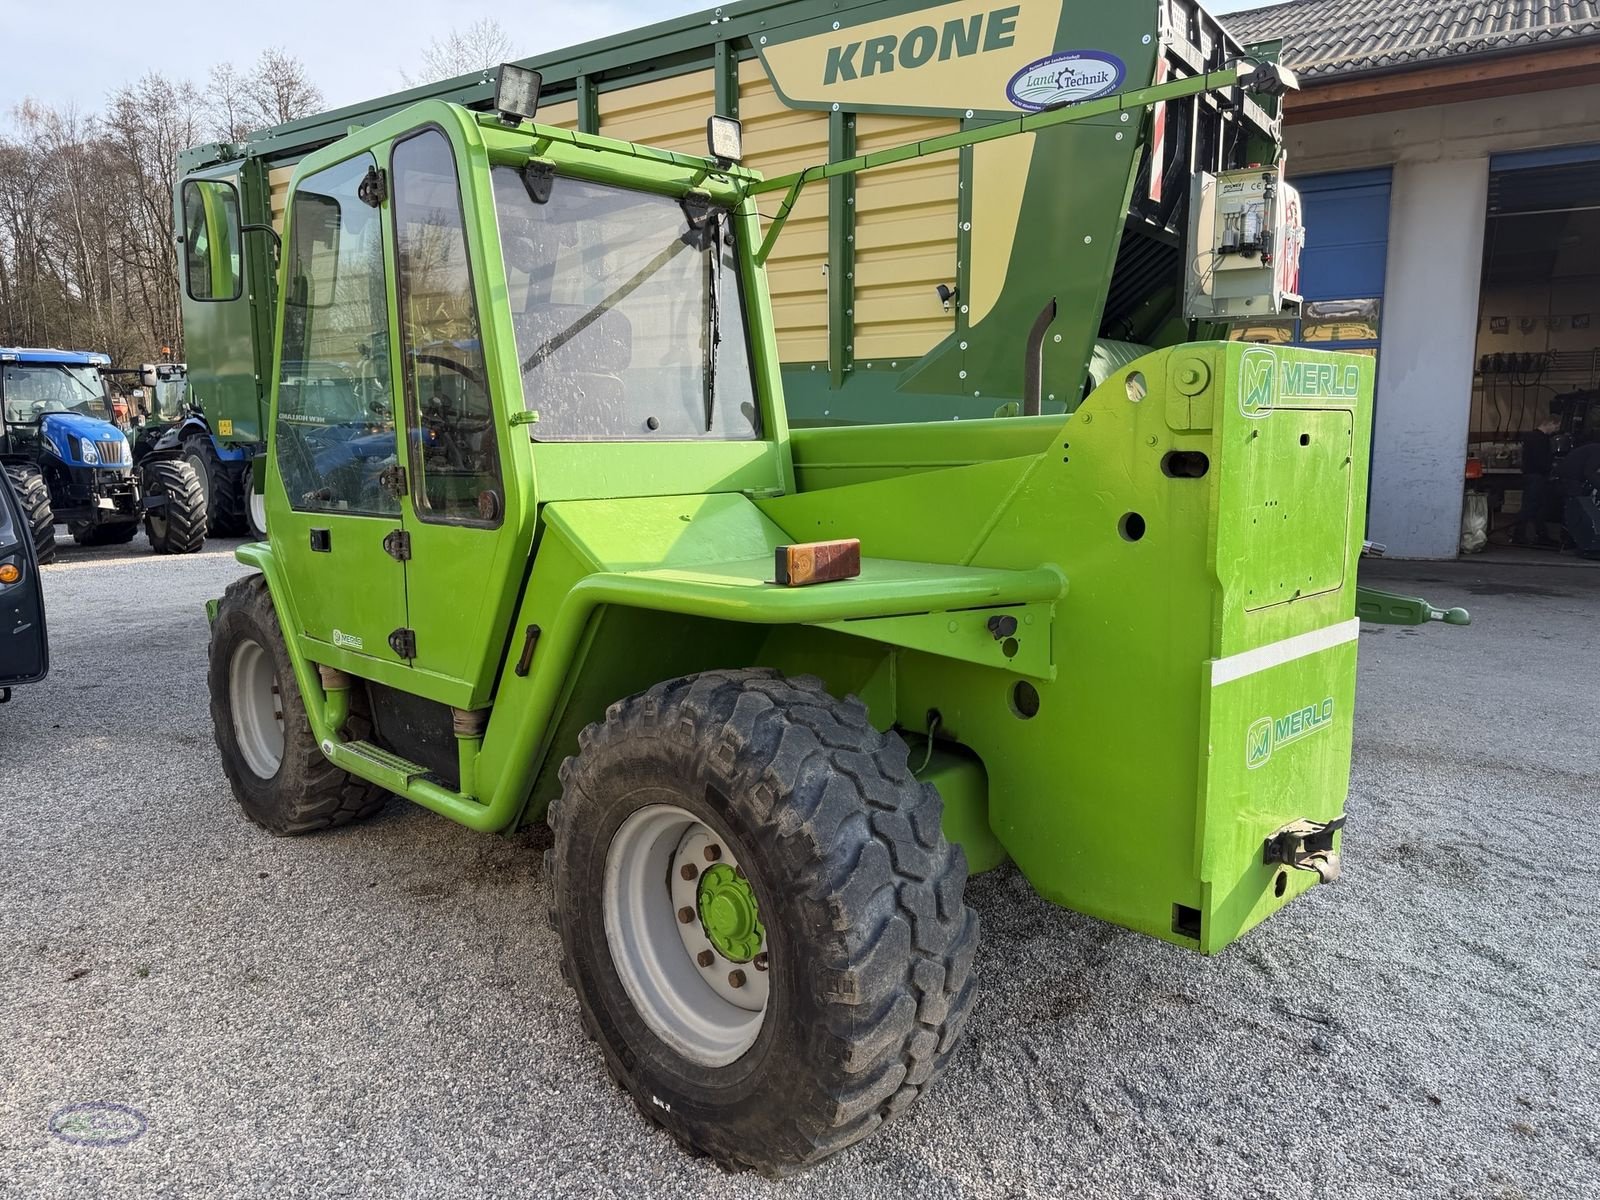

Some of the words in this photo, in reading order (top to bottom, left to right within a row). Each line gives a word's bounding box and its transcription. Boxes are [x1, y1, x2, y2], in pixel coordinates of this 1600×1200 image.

[823, 5, 1021, 86] KRONE
[1026, 72, 1055, 87] Land
[1064, 71, 1109, 88] Technik
[1280, 361, 1359, 397] MERLO
[1274, 697, 1333, 743] MERLO
